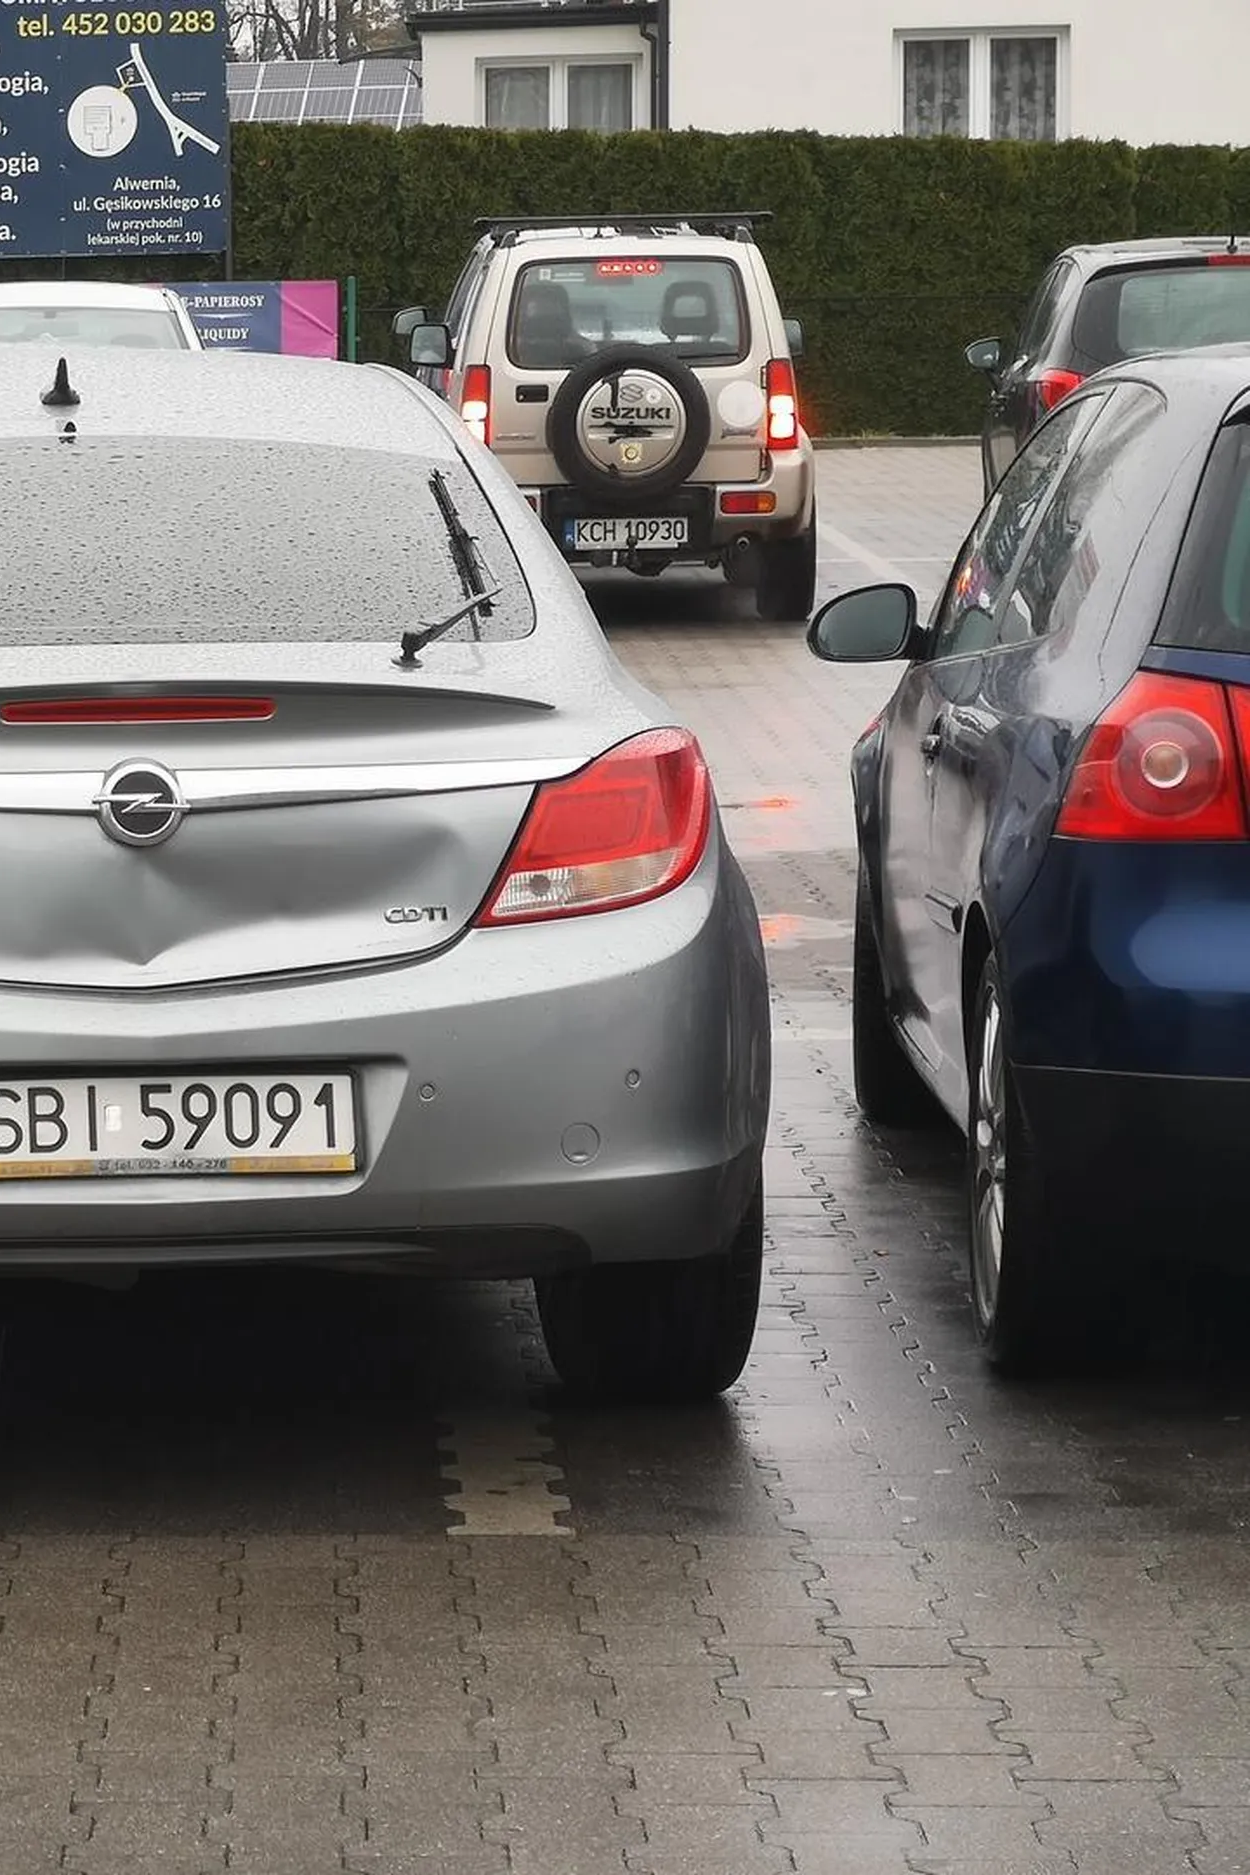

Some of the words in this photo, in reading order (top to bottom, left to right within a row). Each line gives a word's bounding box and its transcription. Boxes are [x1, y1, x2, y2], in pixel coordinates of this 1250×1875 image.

[17, 14, 55, 37] tel.
[62, 13, 109, 36] 452
[115, 12, 162, 35] 030
[169, 10, 216, 33] 283
[113, 177, 180, 192] Alwernia,
[73, 198, 90, 211] ul.
[93, 196, 199, 213] Gęsikowskiego
[203, 194, 222, 208] 16
[106, 219, 121, 231] (w
[123, 217, 183, 233] przychodni
[87, 232, 140, 246] lekarskiej
[142, 232, 165, 245] pok.
[168, 235, 182, 243] nr.
[185, 231, 203, 244] 10)
[590, 406, 671, 421] SUZUKI
[574, 522, 616, 542] KCH
[624, 520, 685, 540] 10930
[384, 906, 448, 925] CDTI
[140, 1081, 338, 1151] 59091
